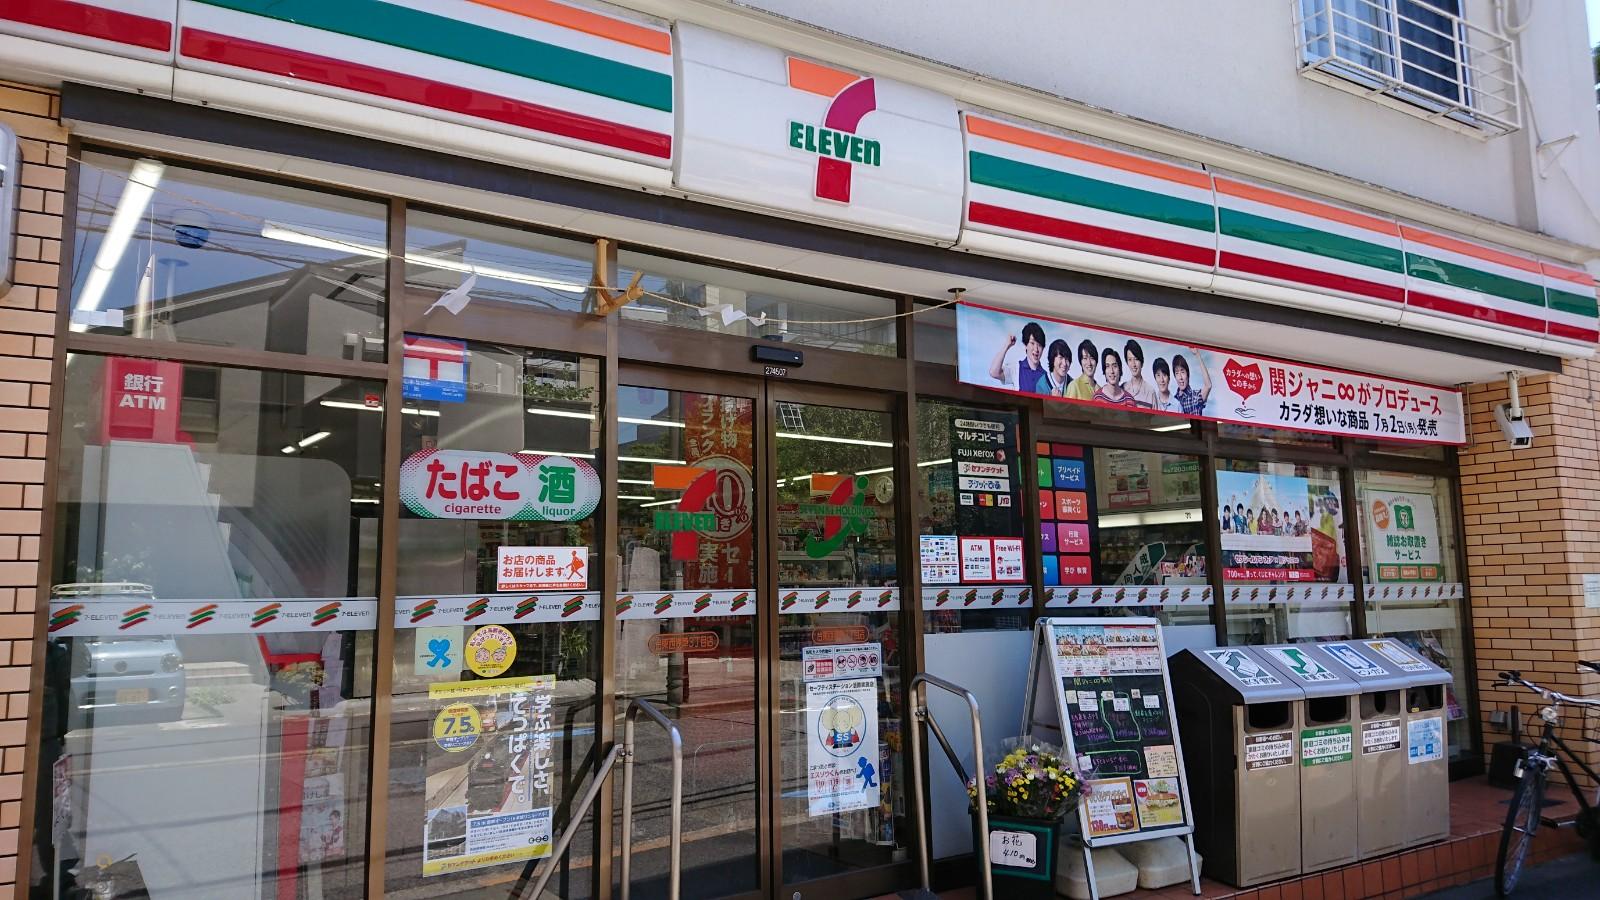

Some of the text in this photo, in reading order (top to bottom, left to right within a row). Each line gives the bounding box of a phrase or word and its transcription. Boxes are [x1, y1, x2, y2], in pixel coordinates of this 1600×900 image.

[1225, 368, 1261, 381] カラダへの想い
[124, 373, 164, 393] 銀行
[1231, 379, 1257, 391] この手から
[1268, 367, 1442, 416] 関ジャニ∞がプロデュース
[118, 393, 166, 410] ATM
[1279, 401, 1369, 431] カラダ想いな商品
[957, 448, 972, 457] FUJI
[425, 458, 520, 501] たばこ
[538, 464, 577, 503] 酒
[1060, 474, 1080, 482] サービス
[444, 502, 502, 515] cigarette
[542, 505, 576, 518] liquor
[502, 554, 556, 566] お店の商品
[1394, 550, 1422, 561] サービス
[1002, 834, 1023, 847] お花
